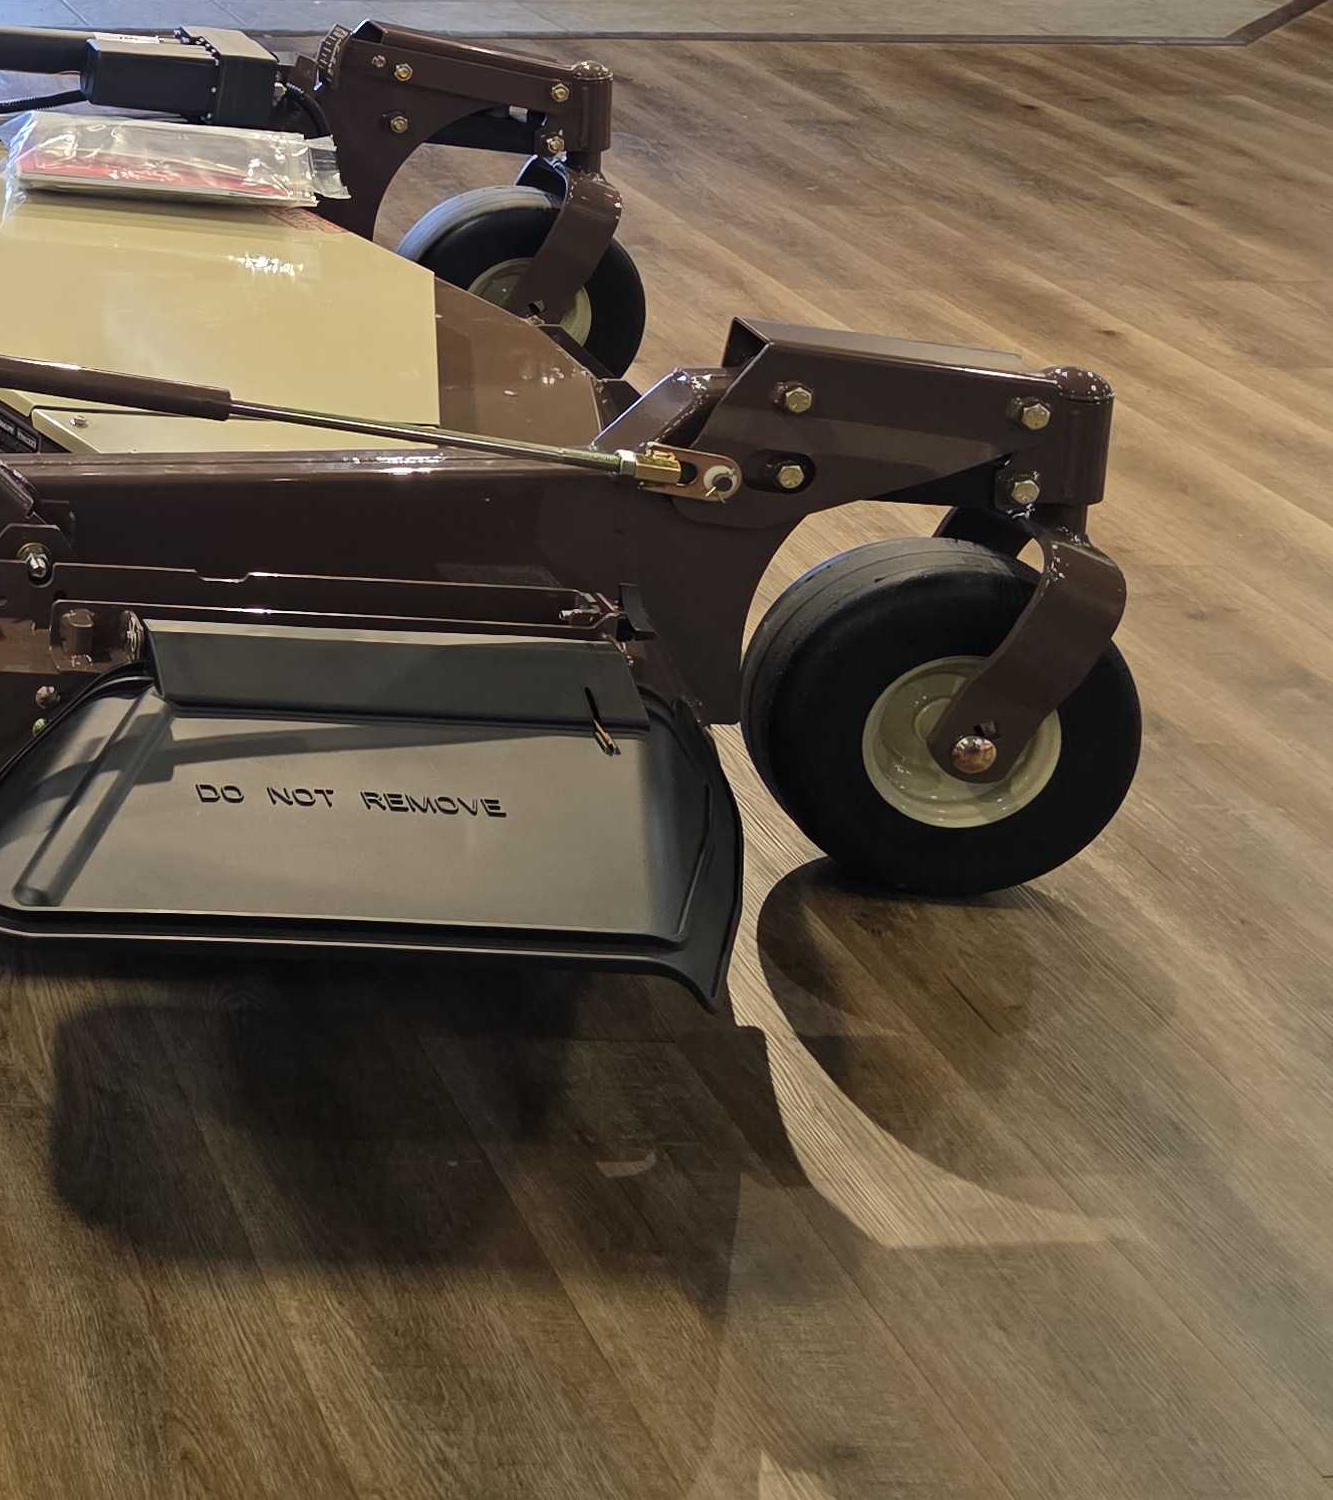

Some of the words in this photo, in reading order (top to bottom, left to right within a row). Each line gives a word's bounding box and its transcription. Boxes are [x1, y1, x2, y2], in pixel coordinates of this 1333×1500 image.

[195, 782, 244, 805] DO
[266, 785, 335, 808] NOT
[360, 790, 508, 818] REMOVE
